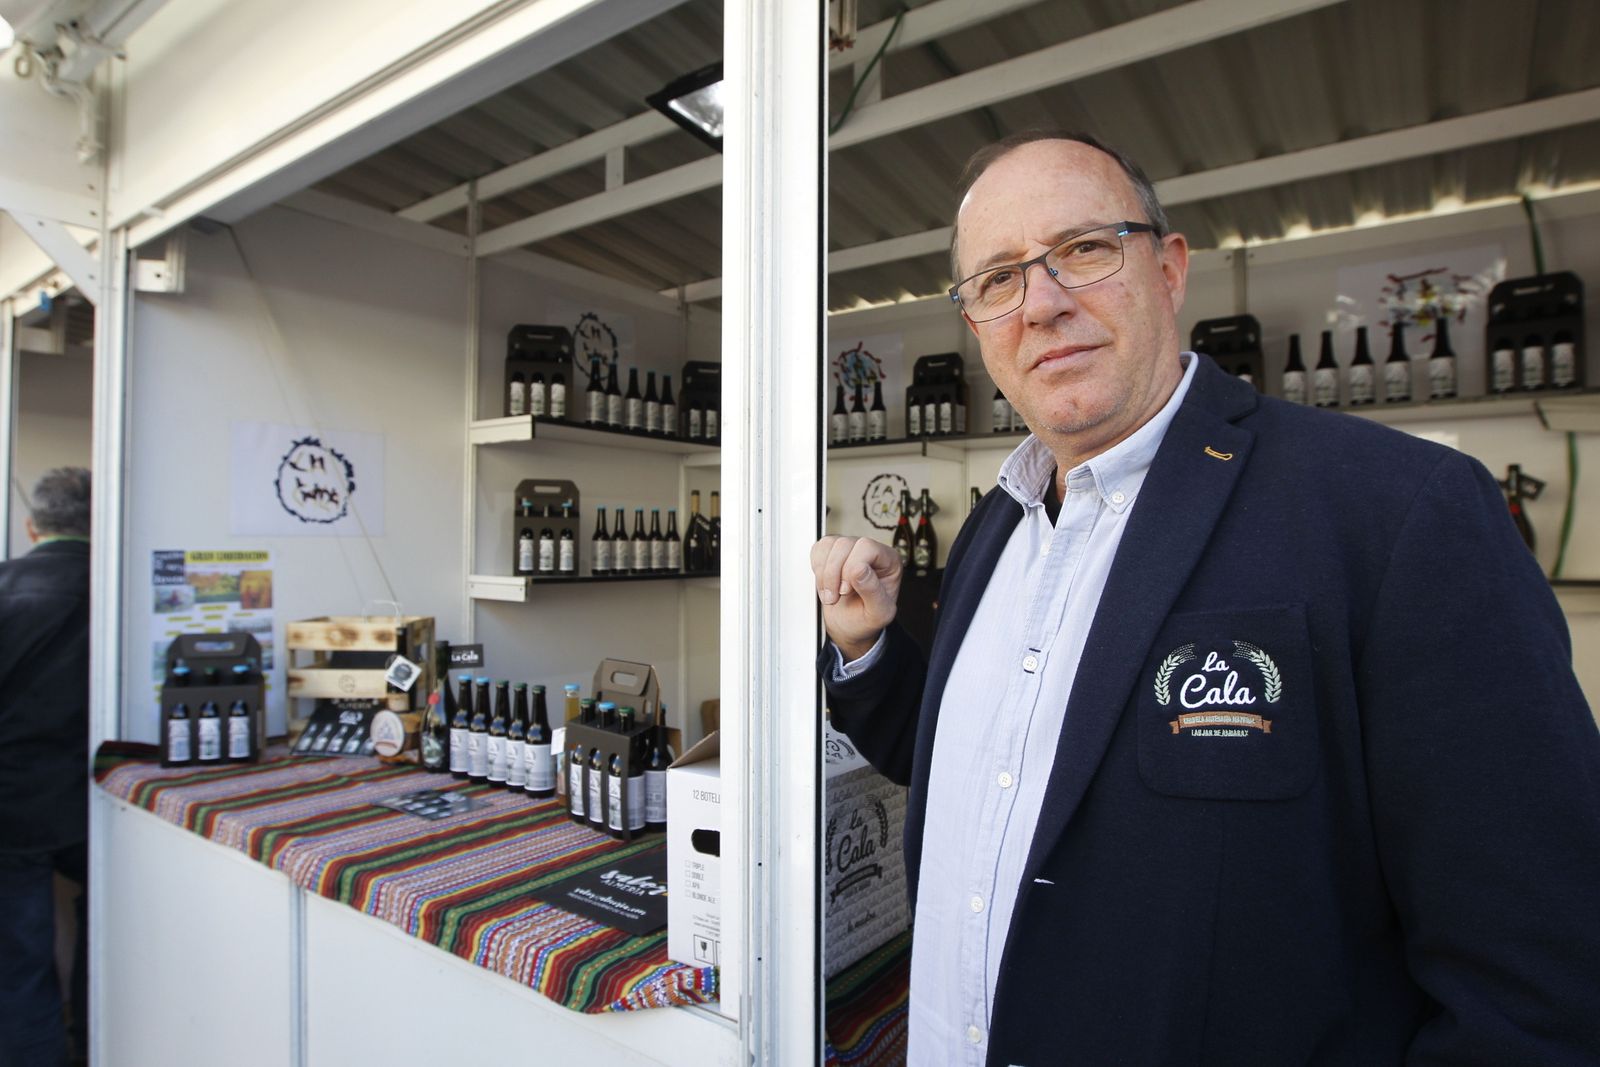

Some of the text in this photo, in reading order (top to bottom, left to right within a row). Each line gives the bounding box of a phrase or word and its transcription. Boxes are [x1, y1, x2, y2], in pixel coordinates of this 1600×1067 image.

[1201, 651, 1230, 672] la
[1180, 671, 1256, 709] Cala
[693, 789, 699, 800] 12
[837, 824, 876, 873] Cala
